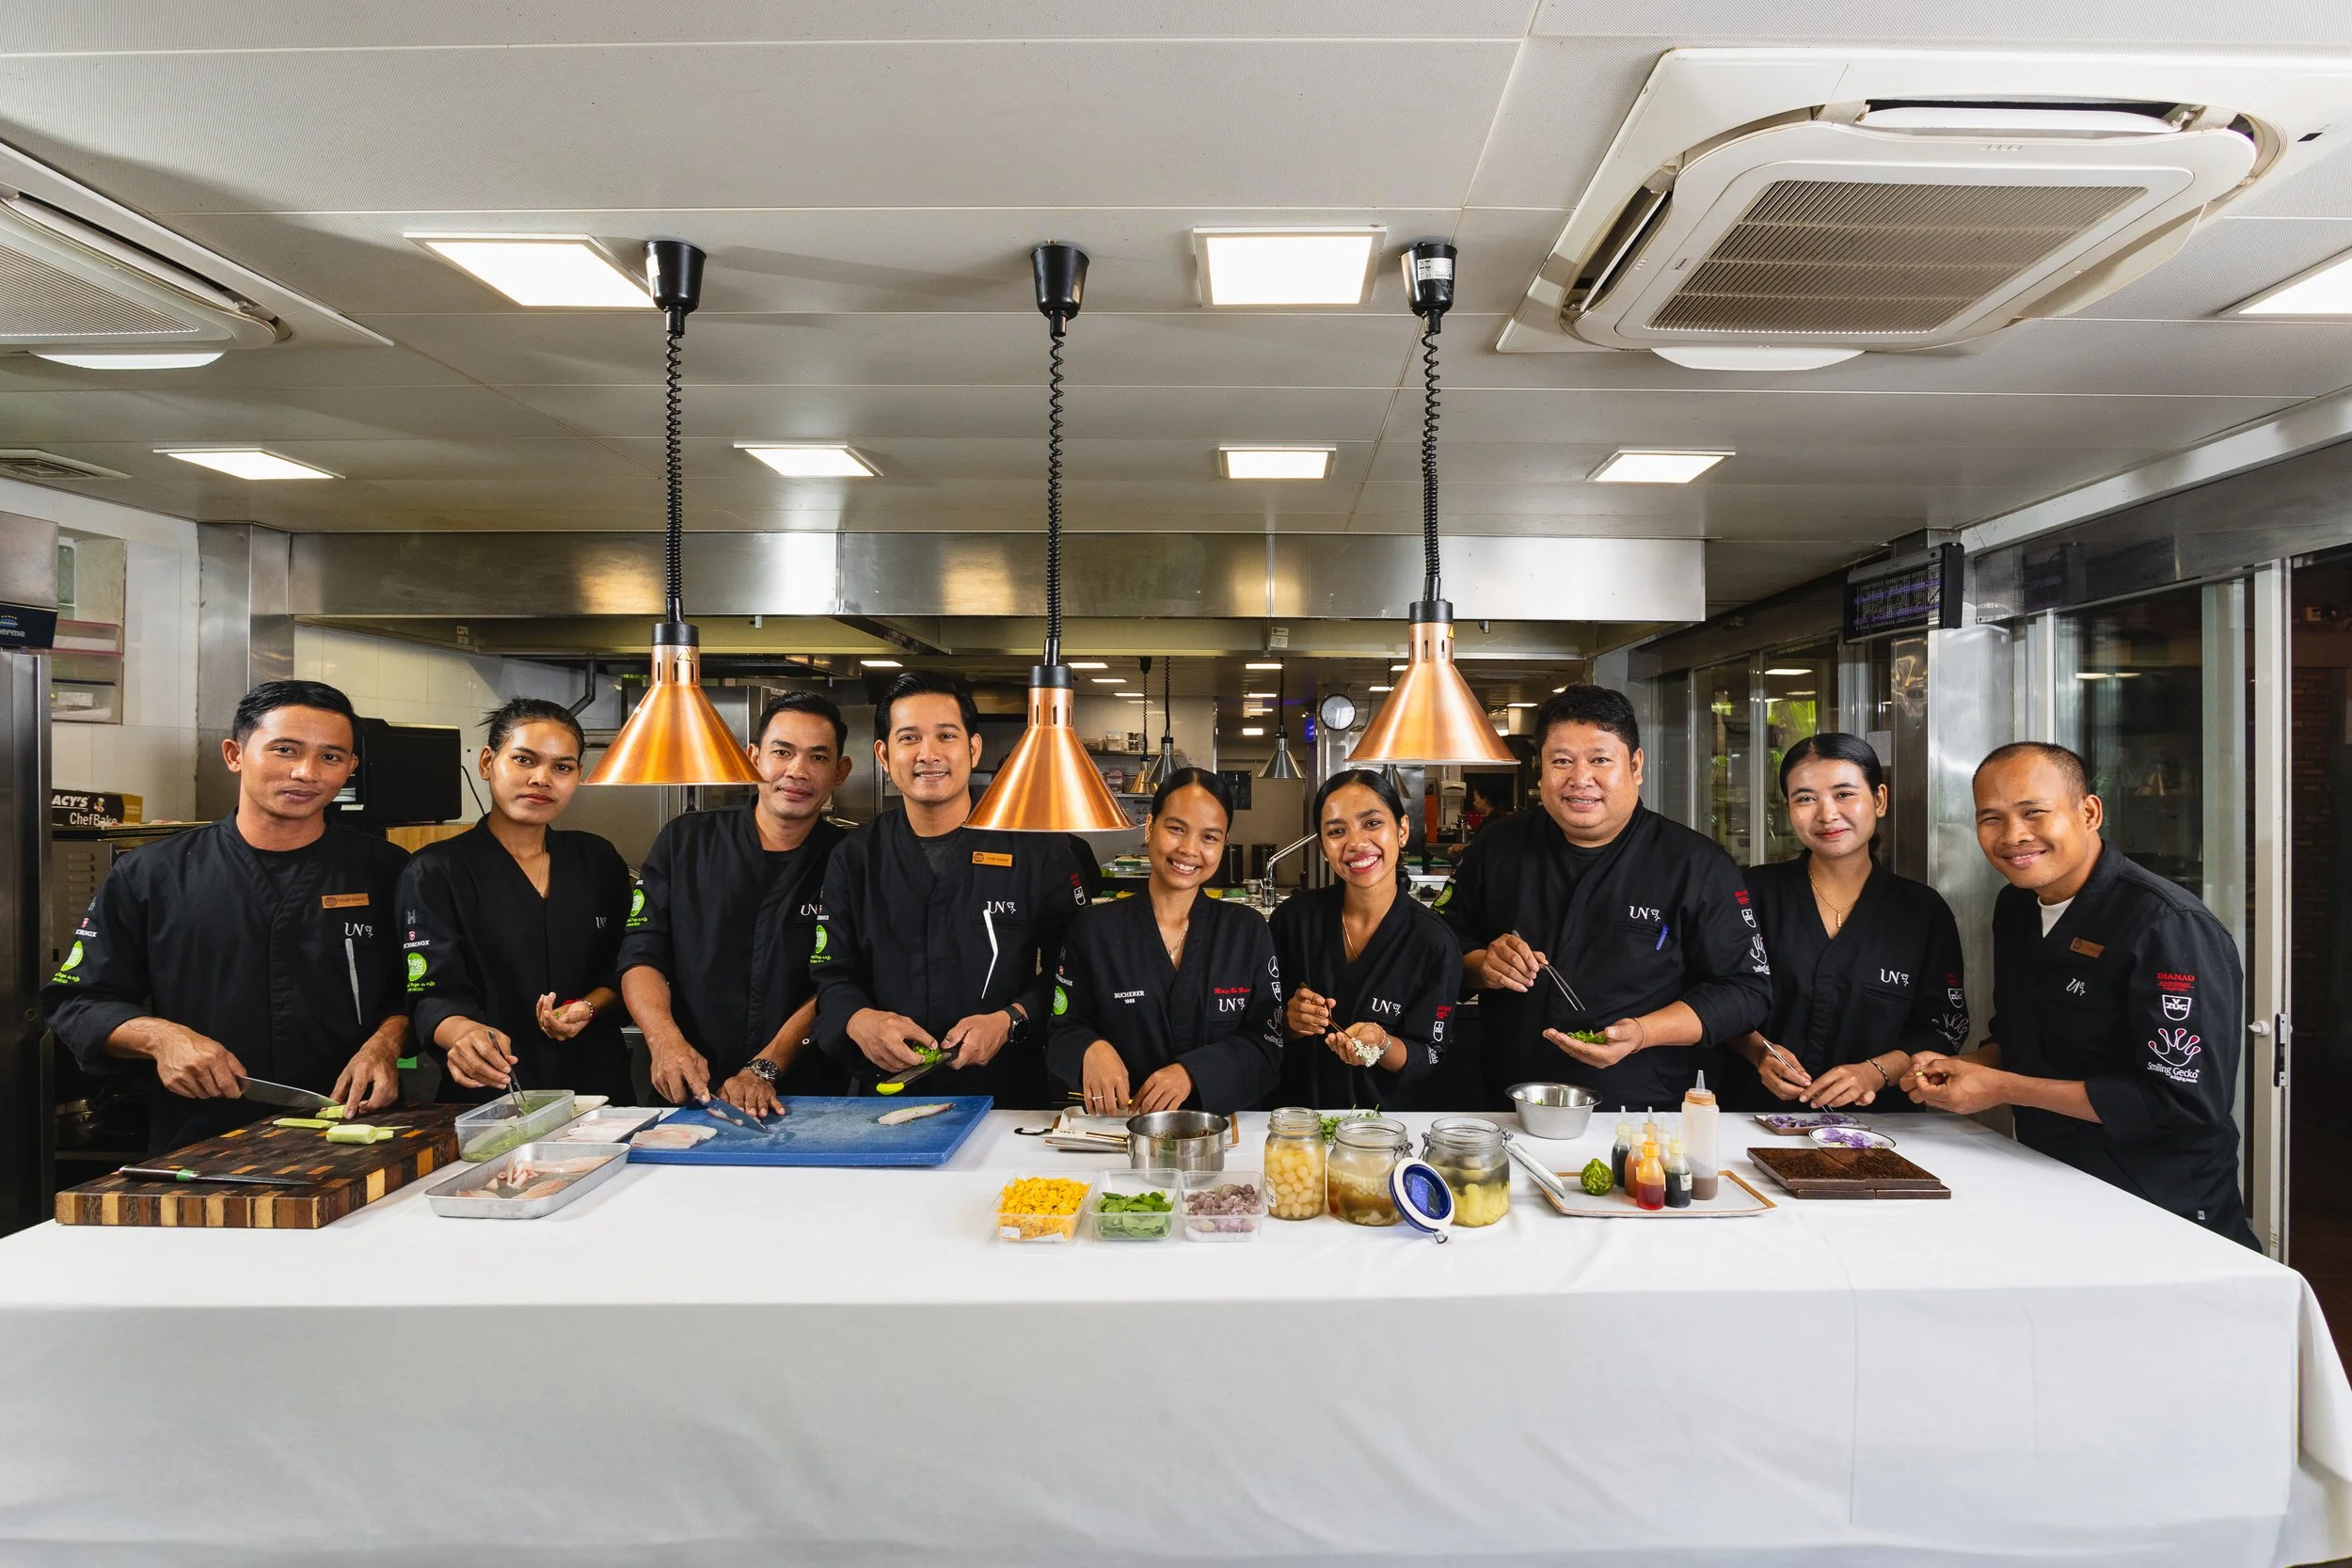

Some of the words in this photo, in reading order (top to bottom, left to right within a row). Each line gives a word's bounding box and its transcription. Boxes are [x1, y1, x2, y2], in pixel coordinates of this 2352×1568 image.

[52, 795, 88, 808] ACY'S
[2165, 1002, 2187, 1011] ZUG
[2147, 1061, 2172, 1076] Smiling
[2172, 1067, 2199, 1079] Gecko
